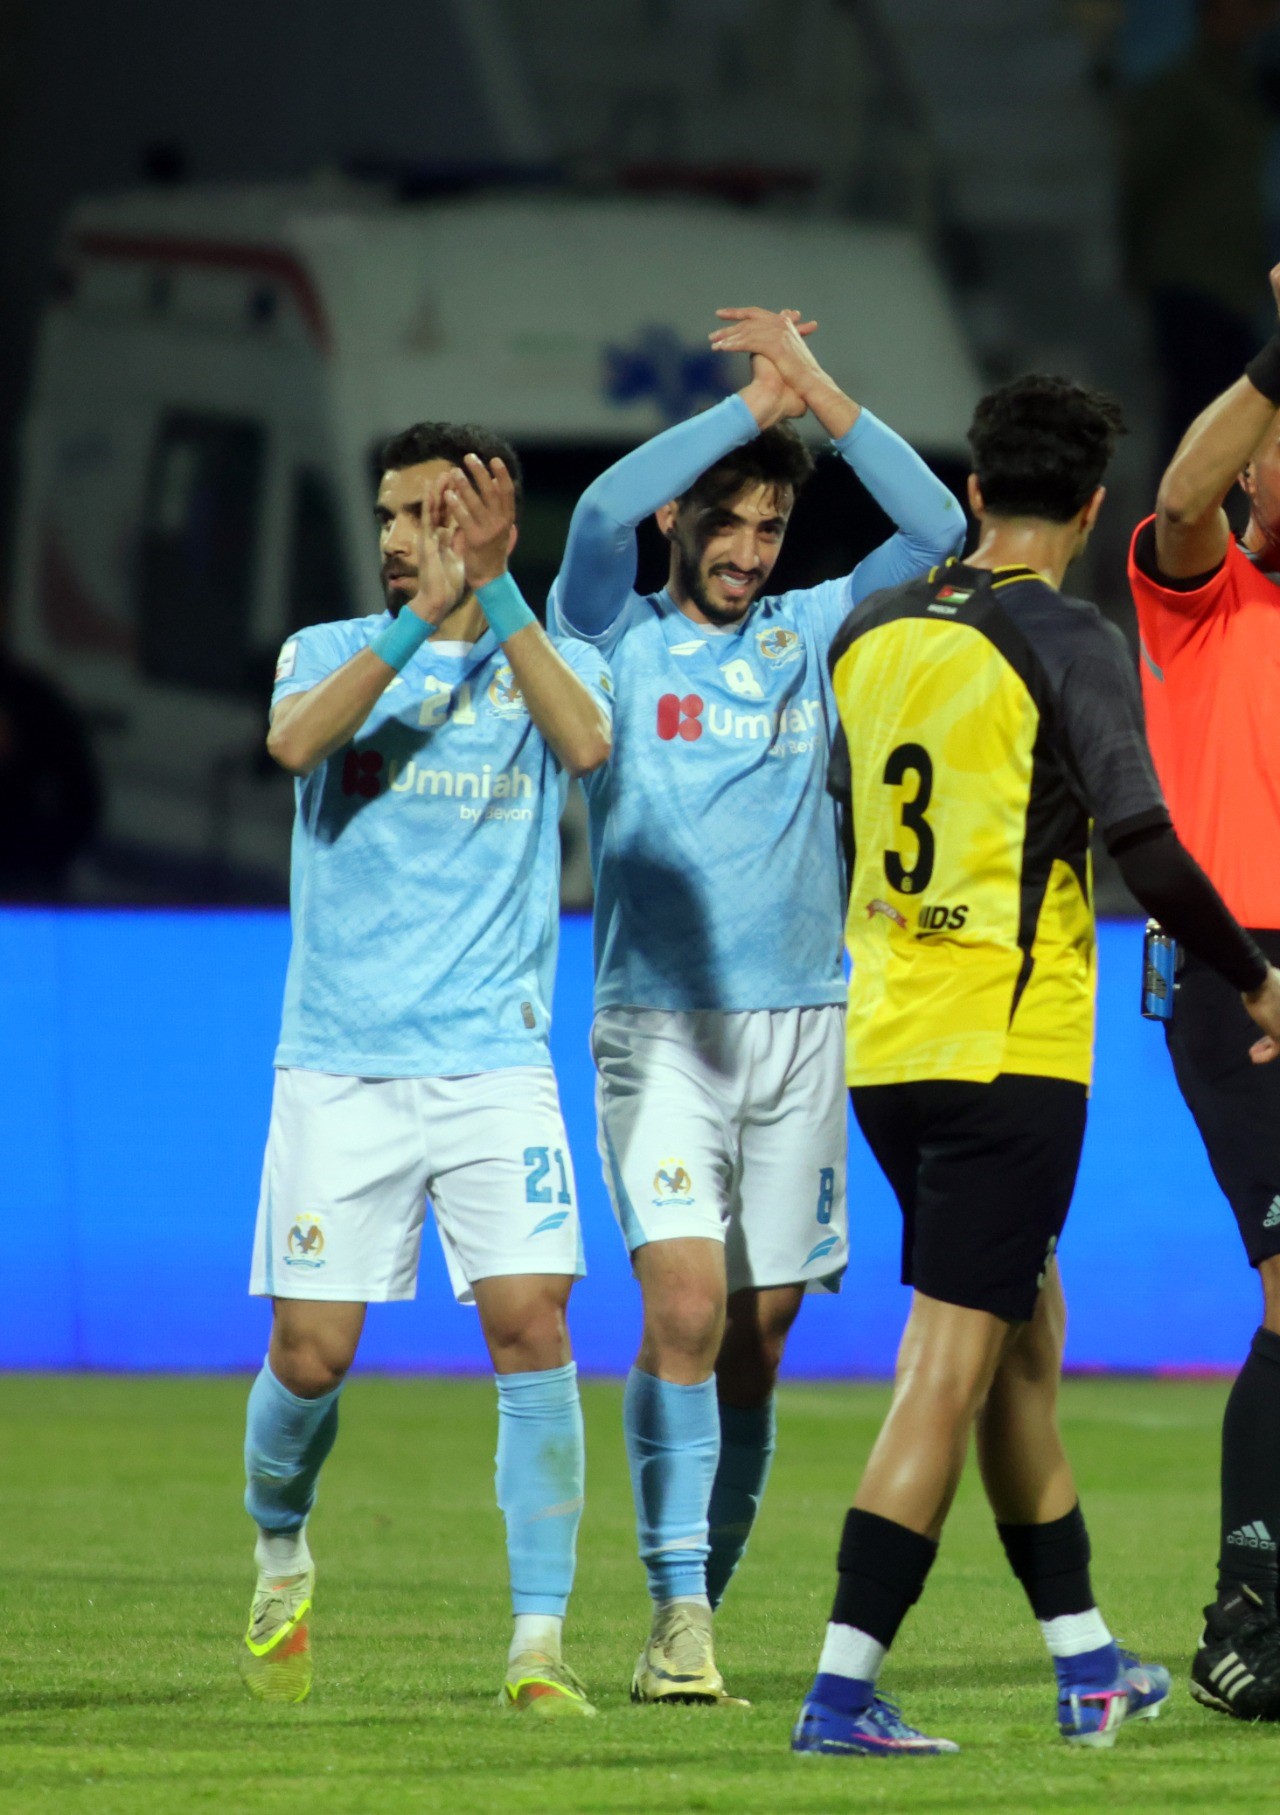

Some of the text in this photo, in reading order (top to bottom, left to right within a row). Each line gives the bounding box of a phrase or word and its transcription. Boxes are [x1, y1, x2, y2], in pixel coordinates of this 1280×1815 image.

[720, 658, 764, 698] 8
[419, 674, 477, 726] 21
[708, 699, 821, 739] Umiah
[389, 760, 532, 798] Umniah
[460, 805, 532, 821] by Beyon
[883, 742, 934, 895] 3
[523, 1146, 571, 1205] 21
[816, 1167, 834, 1225] 8
[1227, 1533, 1276, 1551] adidas
